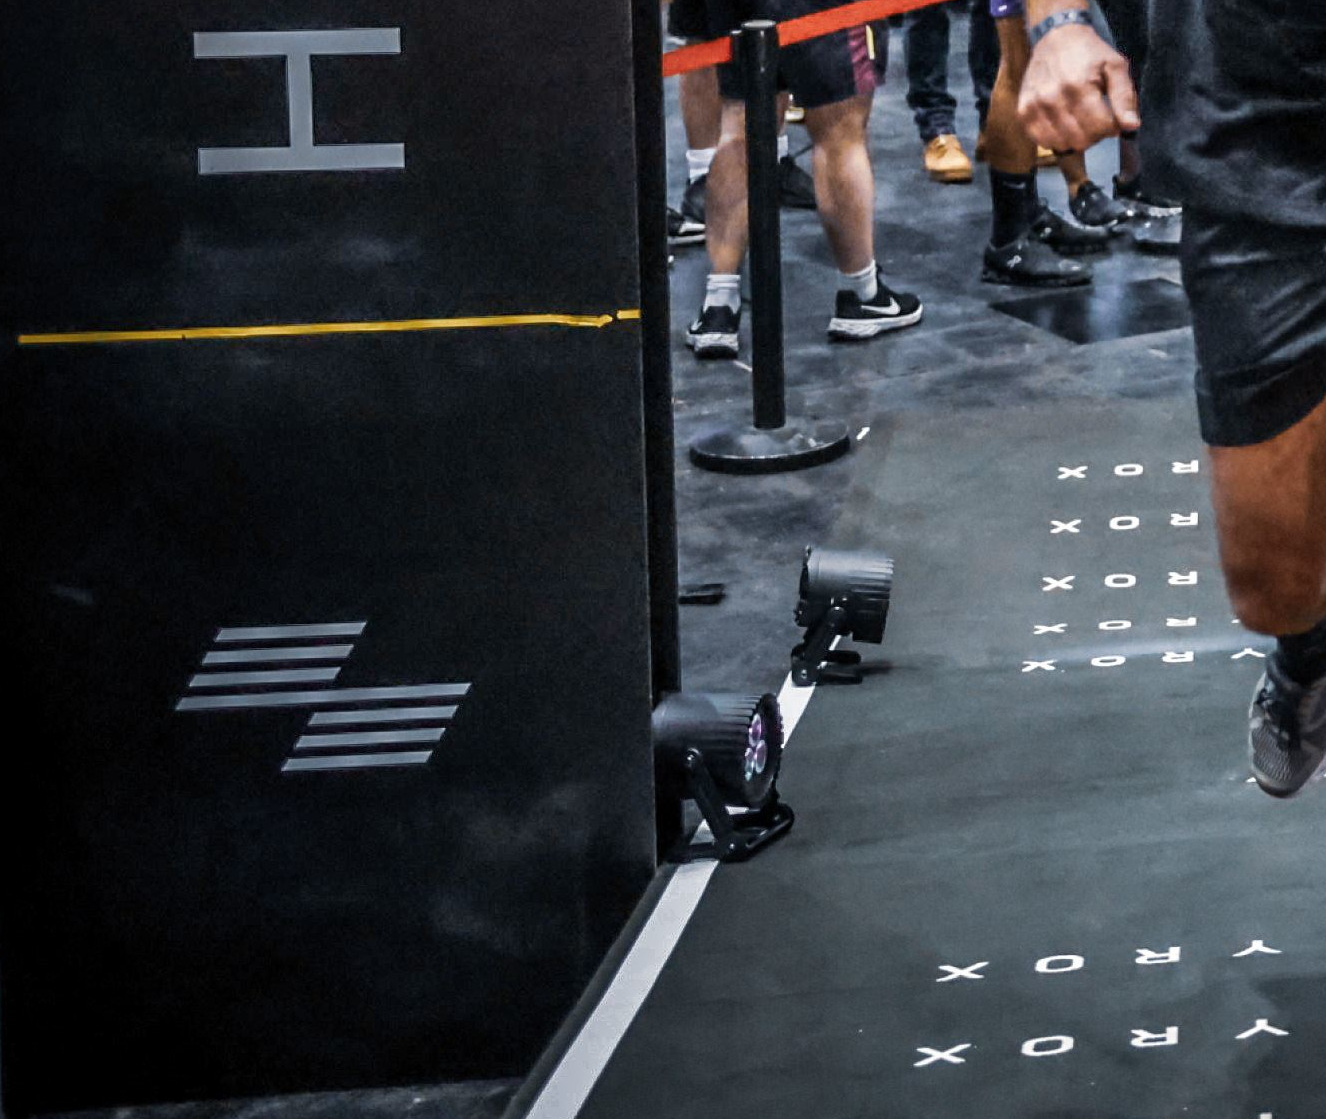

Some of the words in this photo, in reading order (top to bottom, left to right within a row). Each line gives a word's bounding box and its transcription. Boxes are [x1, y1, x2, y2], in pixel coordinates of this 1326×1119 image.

[1057, 459, 1199, 480] ROX
[1050, 511, 1199, 533] ROX
[1042, 569, 1198, 592] ROX
[1033, 616, 1240, 635] ROX
[1021, 646, 1267, 673] YROX
